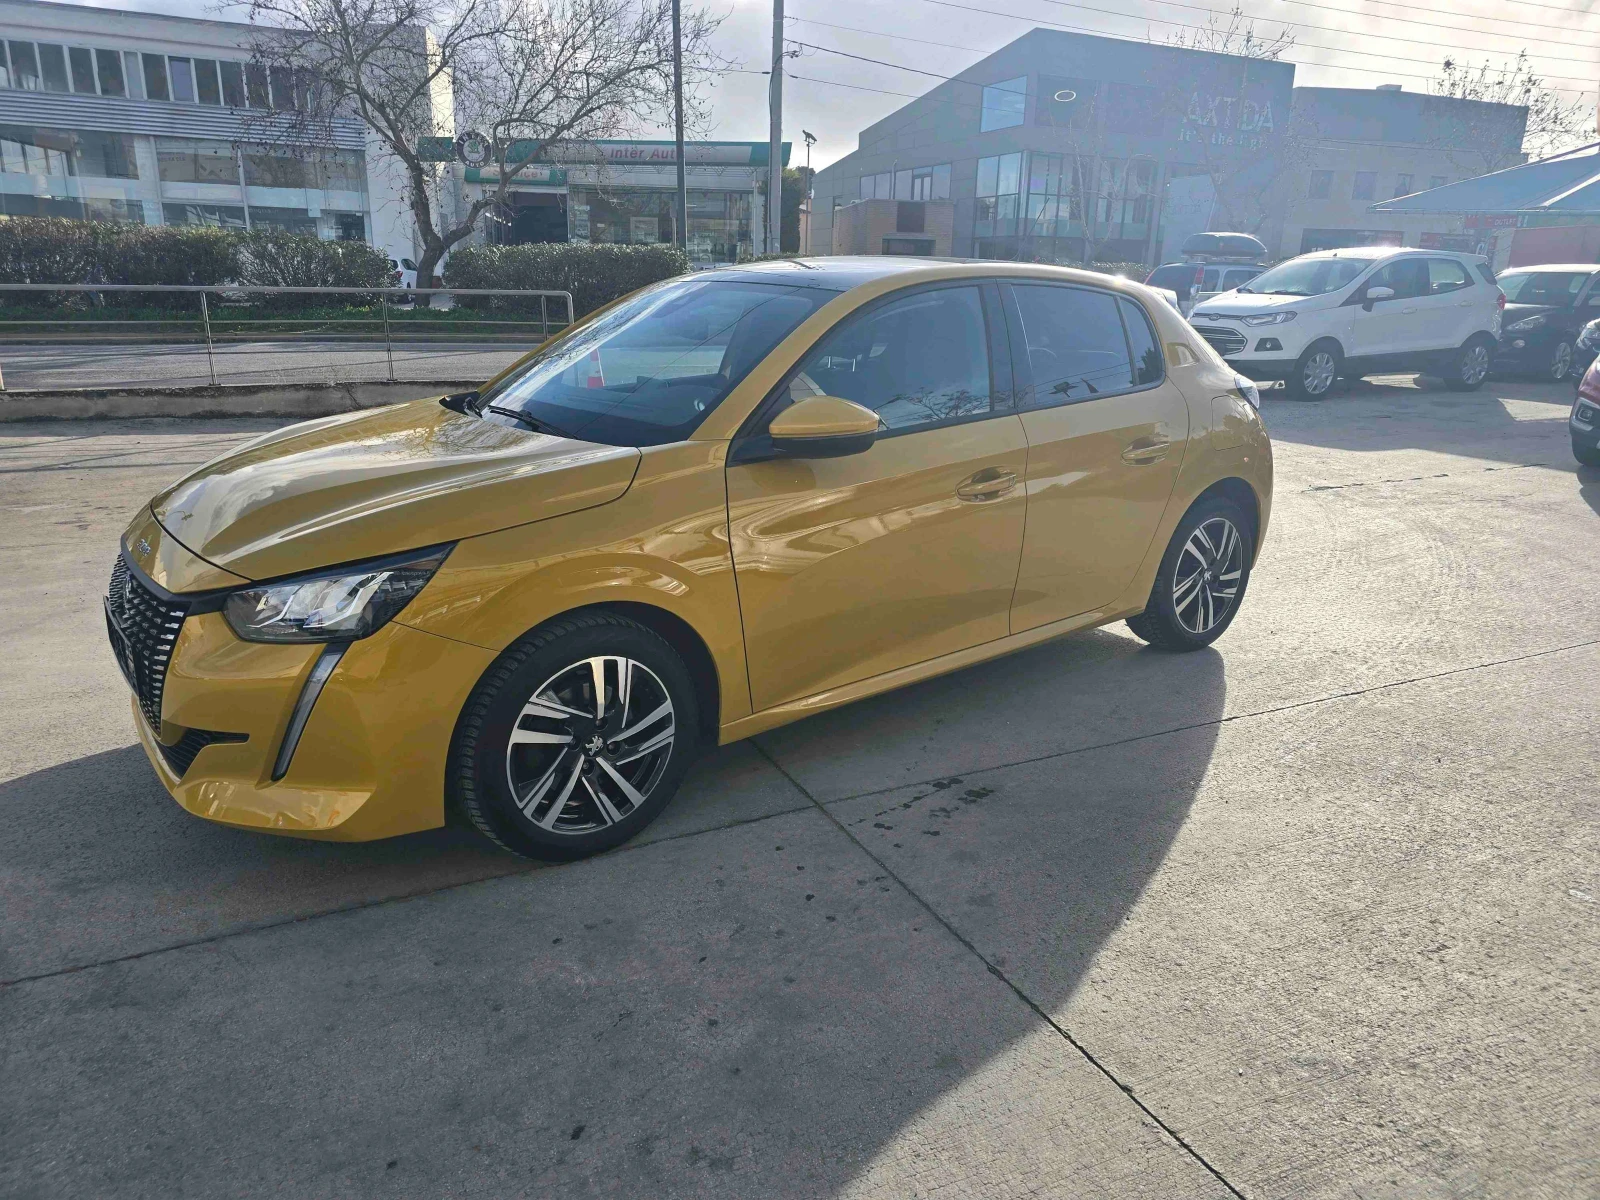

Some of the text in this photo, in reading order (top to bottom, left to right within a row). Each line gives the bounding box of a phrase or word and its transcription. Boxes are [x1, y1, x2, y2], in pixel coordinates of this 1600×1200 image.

[610, 147, 681, 158] Inter Aut
[465, 160, 485, 168] AUTO
